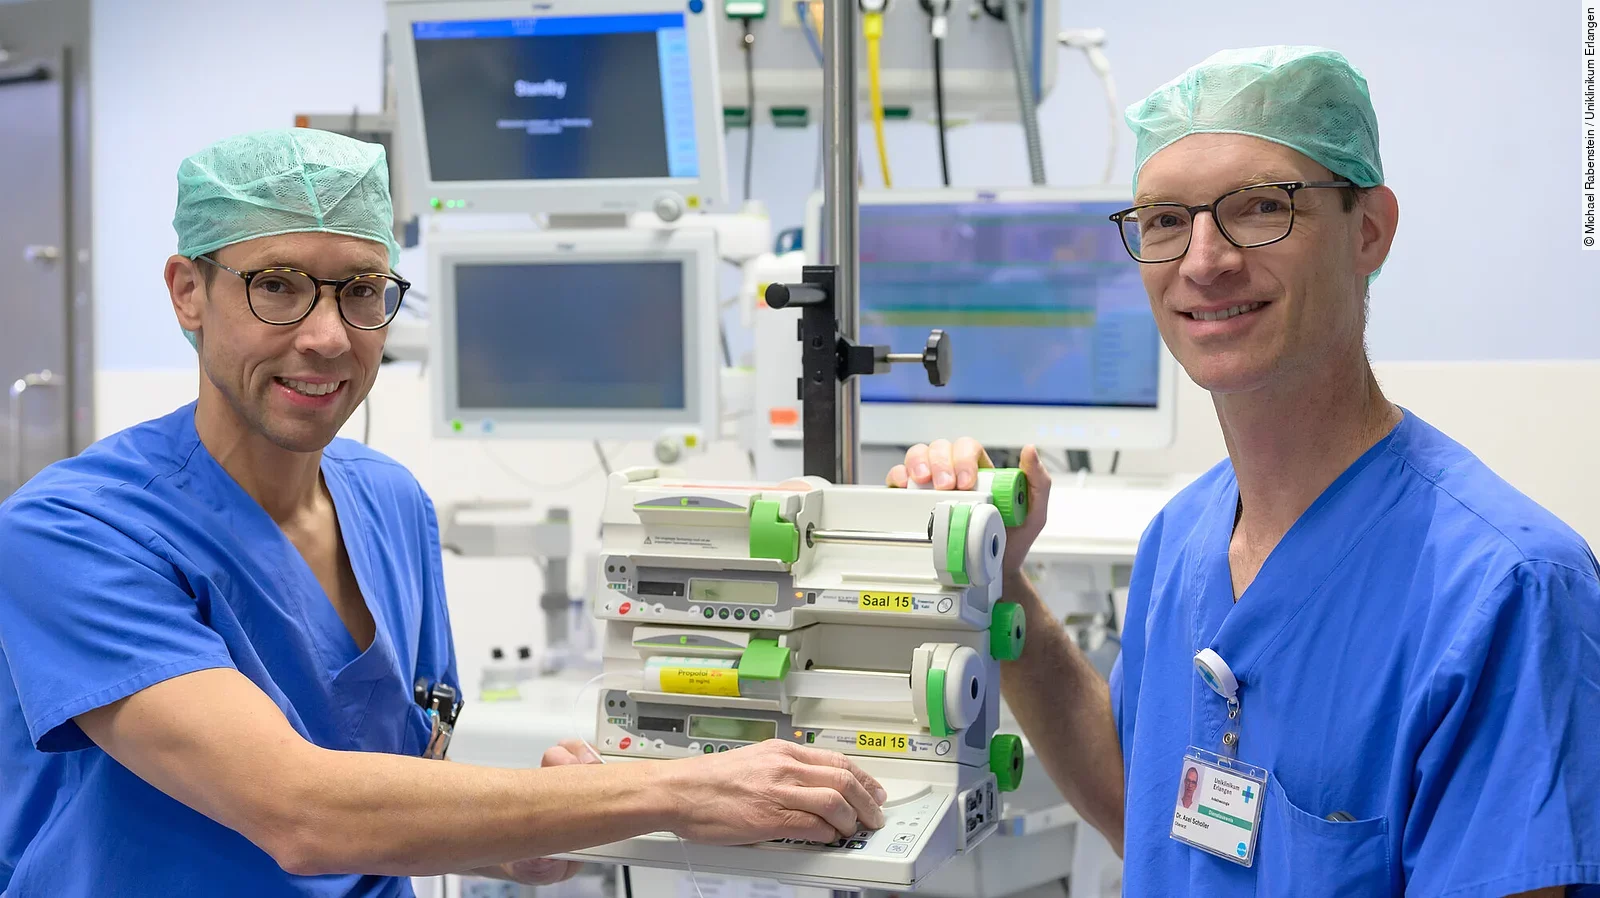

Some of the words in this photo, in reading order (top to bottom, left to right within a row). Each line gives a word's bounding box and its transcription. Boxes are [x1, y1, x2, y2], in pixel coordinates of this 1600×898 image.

[514, 79, 567, 99] Standby
[862, 594, 890, 607] Saal
[894, 596, 909, 608] 15
[858, 734, 886, 747] Saal
[890, 736, 905, 748] 15
[1213, 777, 1240, 791] Uniklinikum
[1213, 784, 1232, 795] Erlangen
